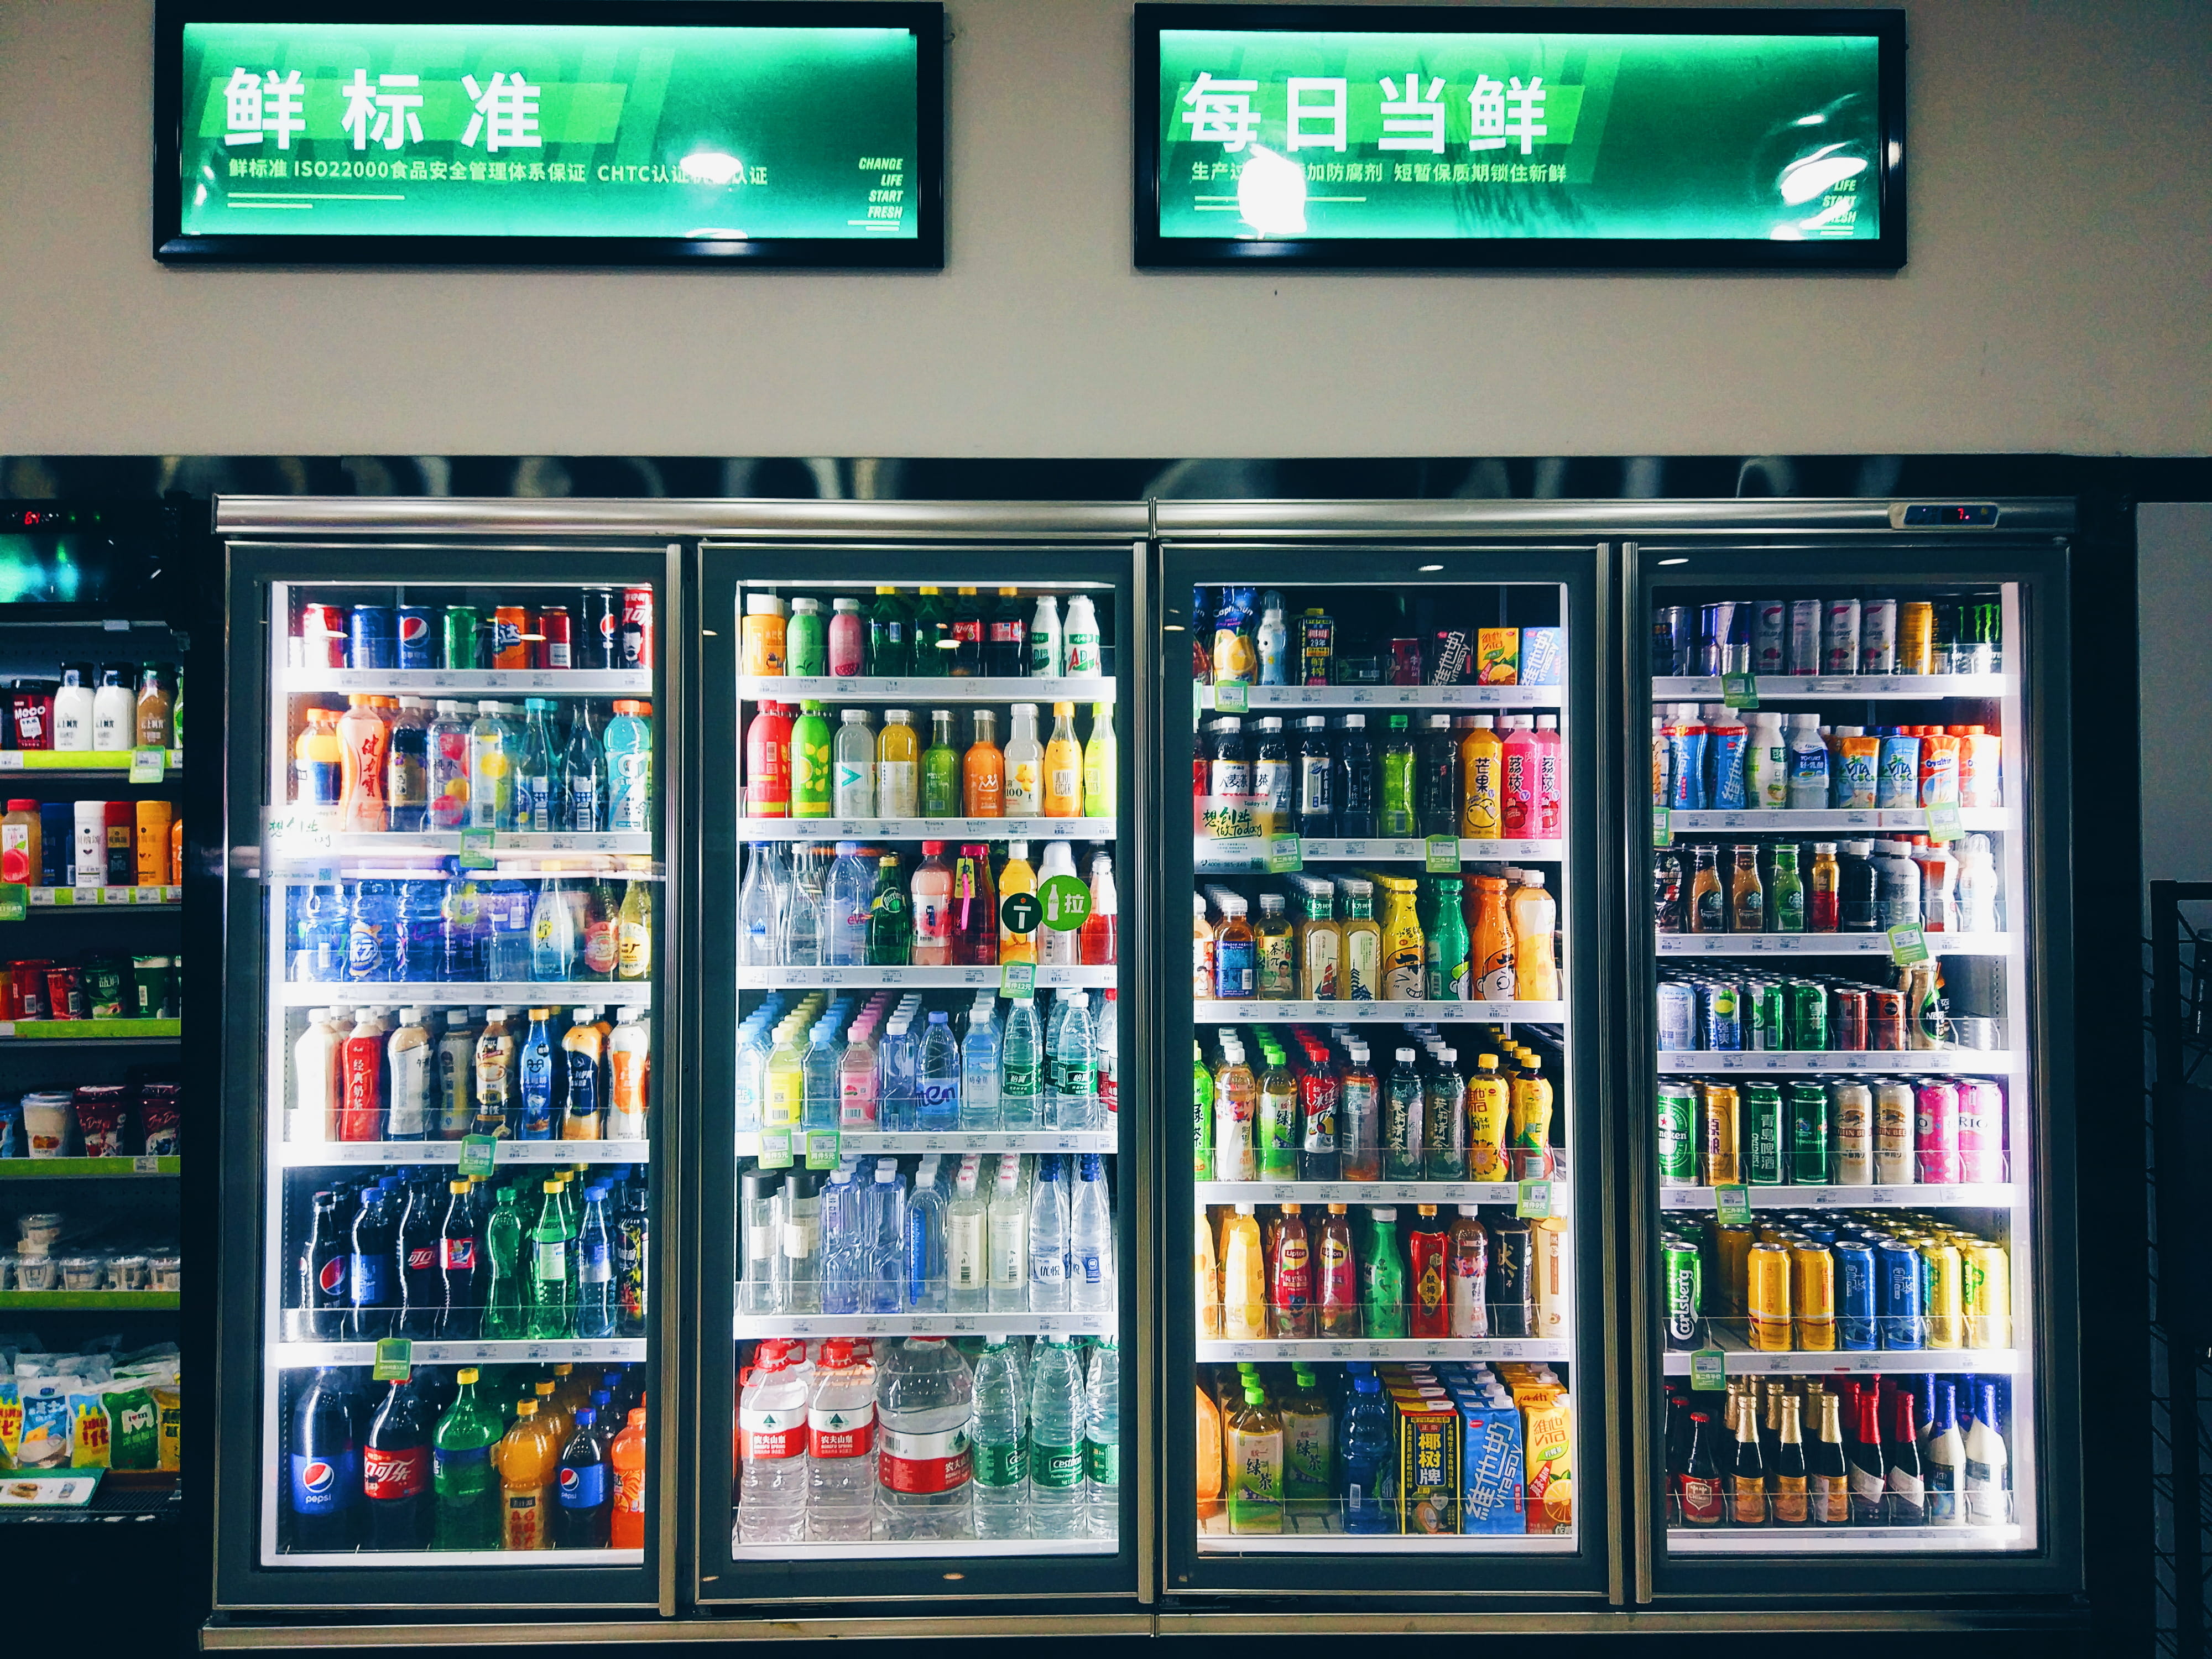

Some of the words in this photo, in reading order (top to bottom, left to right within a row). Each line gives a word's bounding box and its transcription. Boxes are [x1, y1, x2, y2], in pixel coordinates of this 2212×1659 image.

[223, 66, 542, 153] 鲜标准
[1182, 71, 1547, 154] 每日当鲜
[229, 158, 287, 178] 鲜标准
[598, 165, 768, 185] CHTC认证认证
[859, 157, 903, 170] CHANGE
[1192, 161, 1383, 182] 生产过加防腐剂
[1394, 163, 1567, 182] 短暂保质期锁住新鲜
[881, 174, 903, 187] LIFE
[868, 190, 903, 203] START
[867, 206, 903, 219] FRESH
[1475, 758, 1490, 793] 芒果
[1509, 757, 1522, 792] 荔枝
[1065, 893, 1084, 914] 拉
[1671, 1269, 1694, 1340] Carlsberg
[821, 1436, 853, 1444] 农夫山泉
[1418, 1433, 1442, 1485] 椰树牌
[306, 1494, 332, 1504] pepsi
